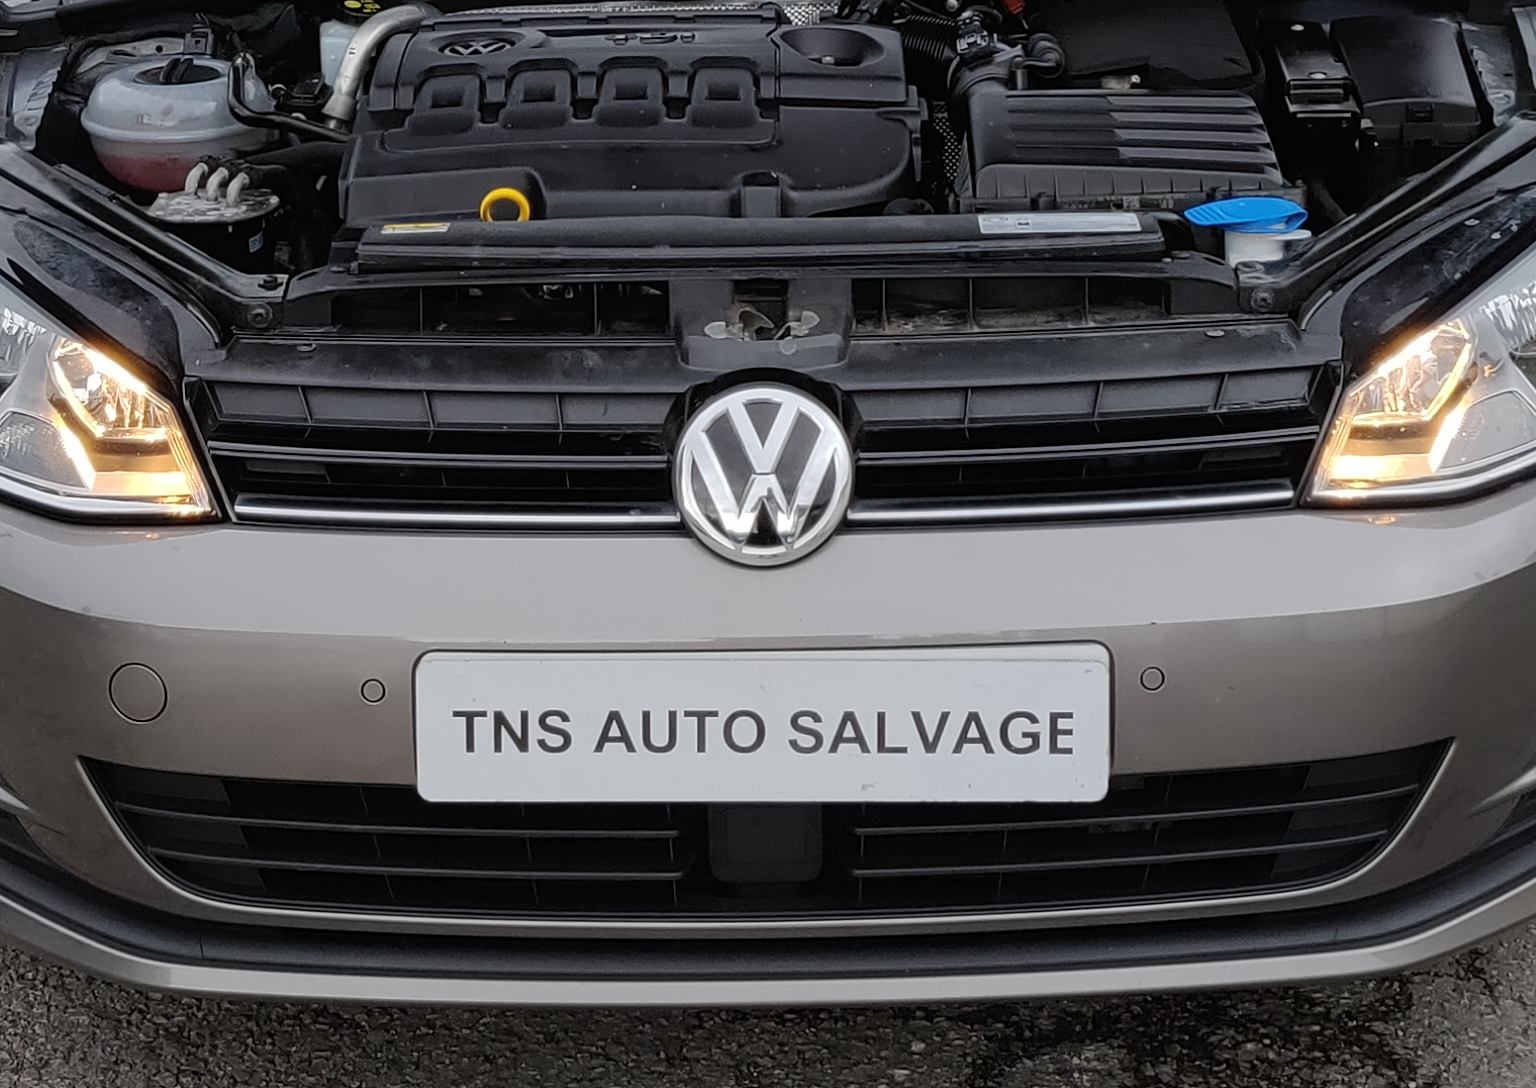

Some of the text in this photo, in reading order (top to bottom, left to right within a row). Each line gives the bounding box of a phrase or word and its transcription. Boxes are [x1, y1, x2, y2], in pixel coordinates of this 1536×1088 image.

[453, 709, 1074, 755] TNS AUTO SALVAGE
